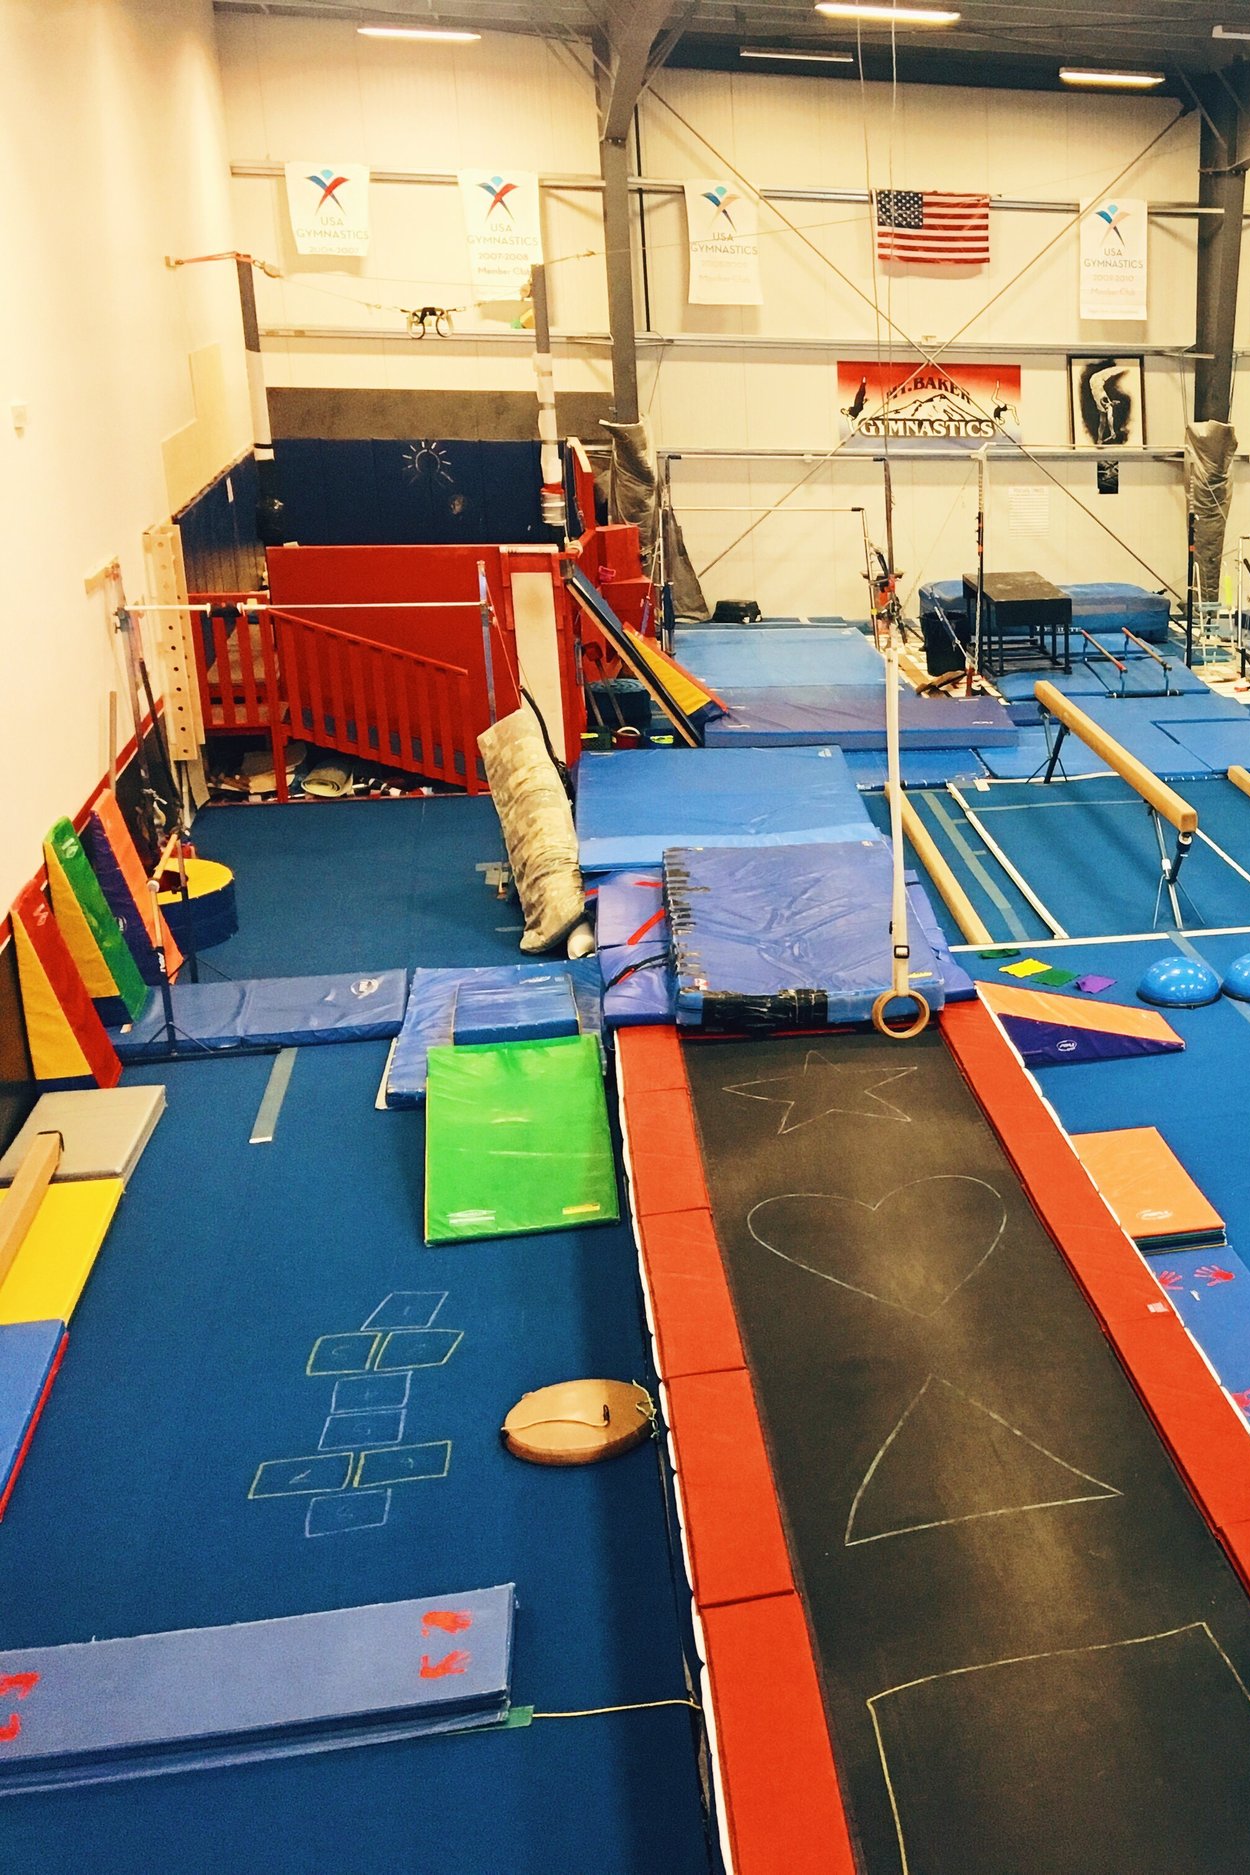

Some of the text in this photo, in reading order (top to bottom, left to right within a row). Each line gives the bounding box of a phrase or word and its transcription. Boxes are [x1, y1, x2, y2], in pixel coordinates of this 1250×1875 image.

[320, 216, 344, 226] USA
[490, 223, 512, 232] USA
[296, 229, 369, 240] GYMNASTICS
[712, 232, 733, 241] USA
[466, 235, 539, 246] GYMNASTICS
[691, 243, 759, 255] GYMNASTICS
[1104, 247, 1122, 257] USA
[1084, 258, 1144, 269] GYMNASTICS
[860, 419, 995, 438] GYMNASTICS
